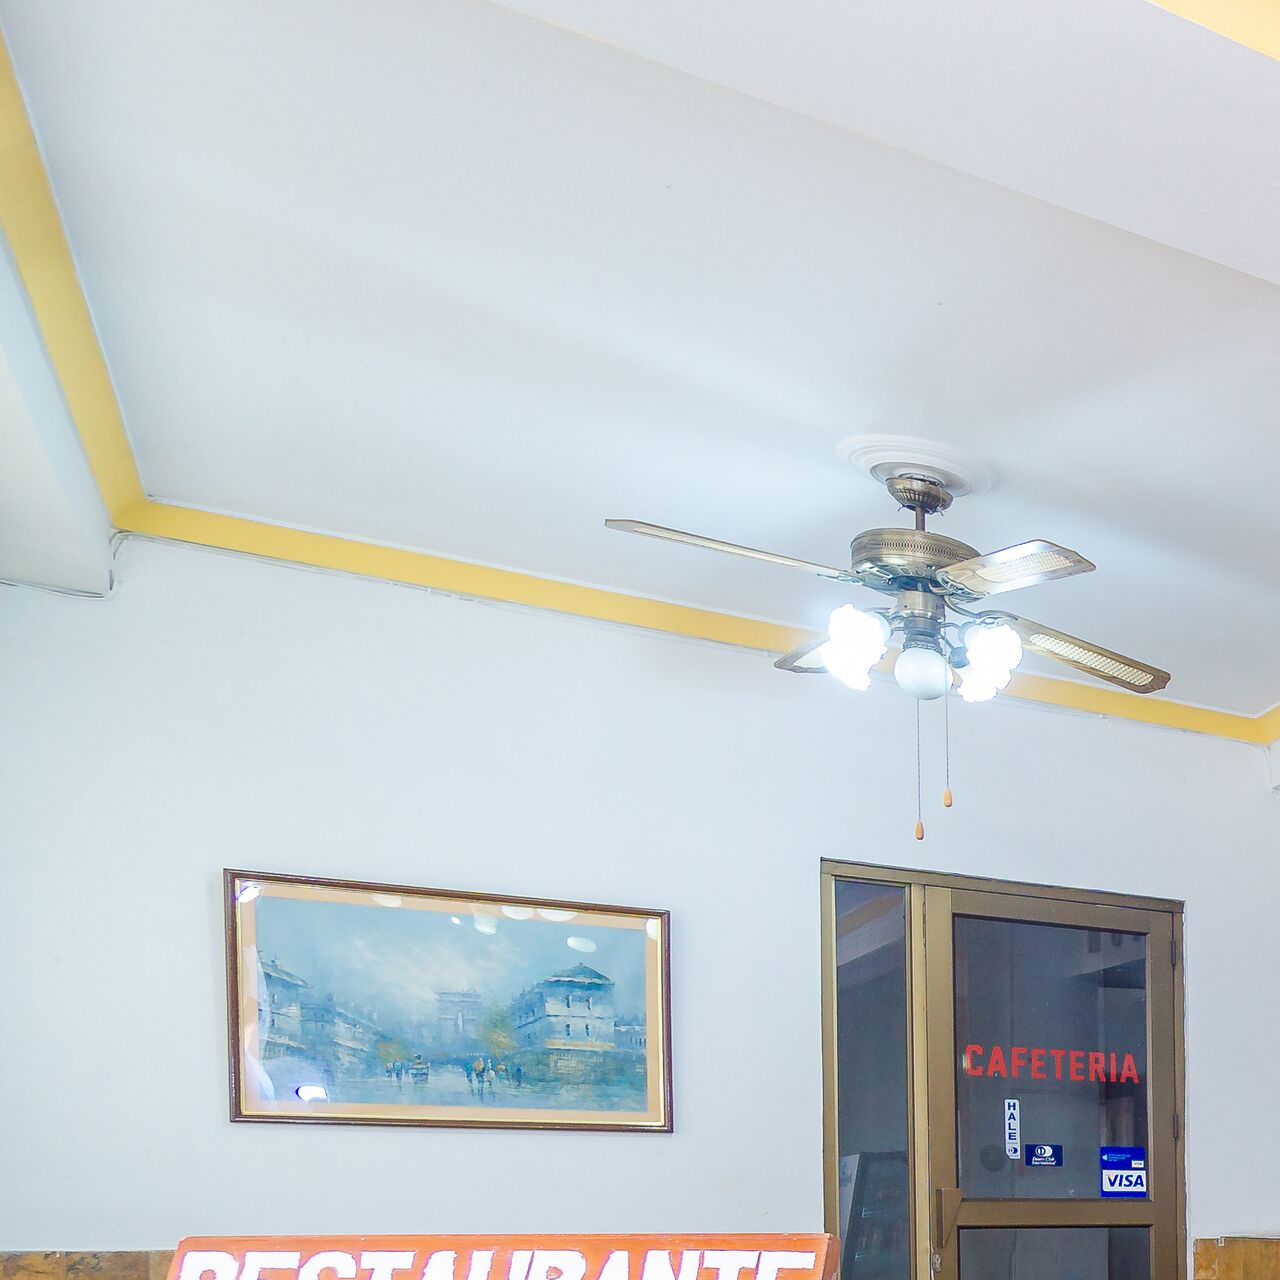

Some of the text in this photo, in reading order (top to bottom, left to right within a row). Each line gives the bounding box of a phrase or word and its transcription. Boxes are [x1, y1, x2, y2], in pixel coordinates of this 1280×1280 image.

[964, 1044, 1140, 1085] CAFETERIA
[1007, 1102, 1017, 1141] HALE
[1106, 1174, 1145, 1188] VISA
